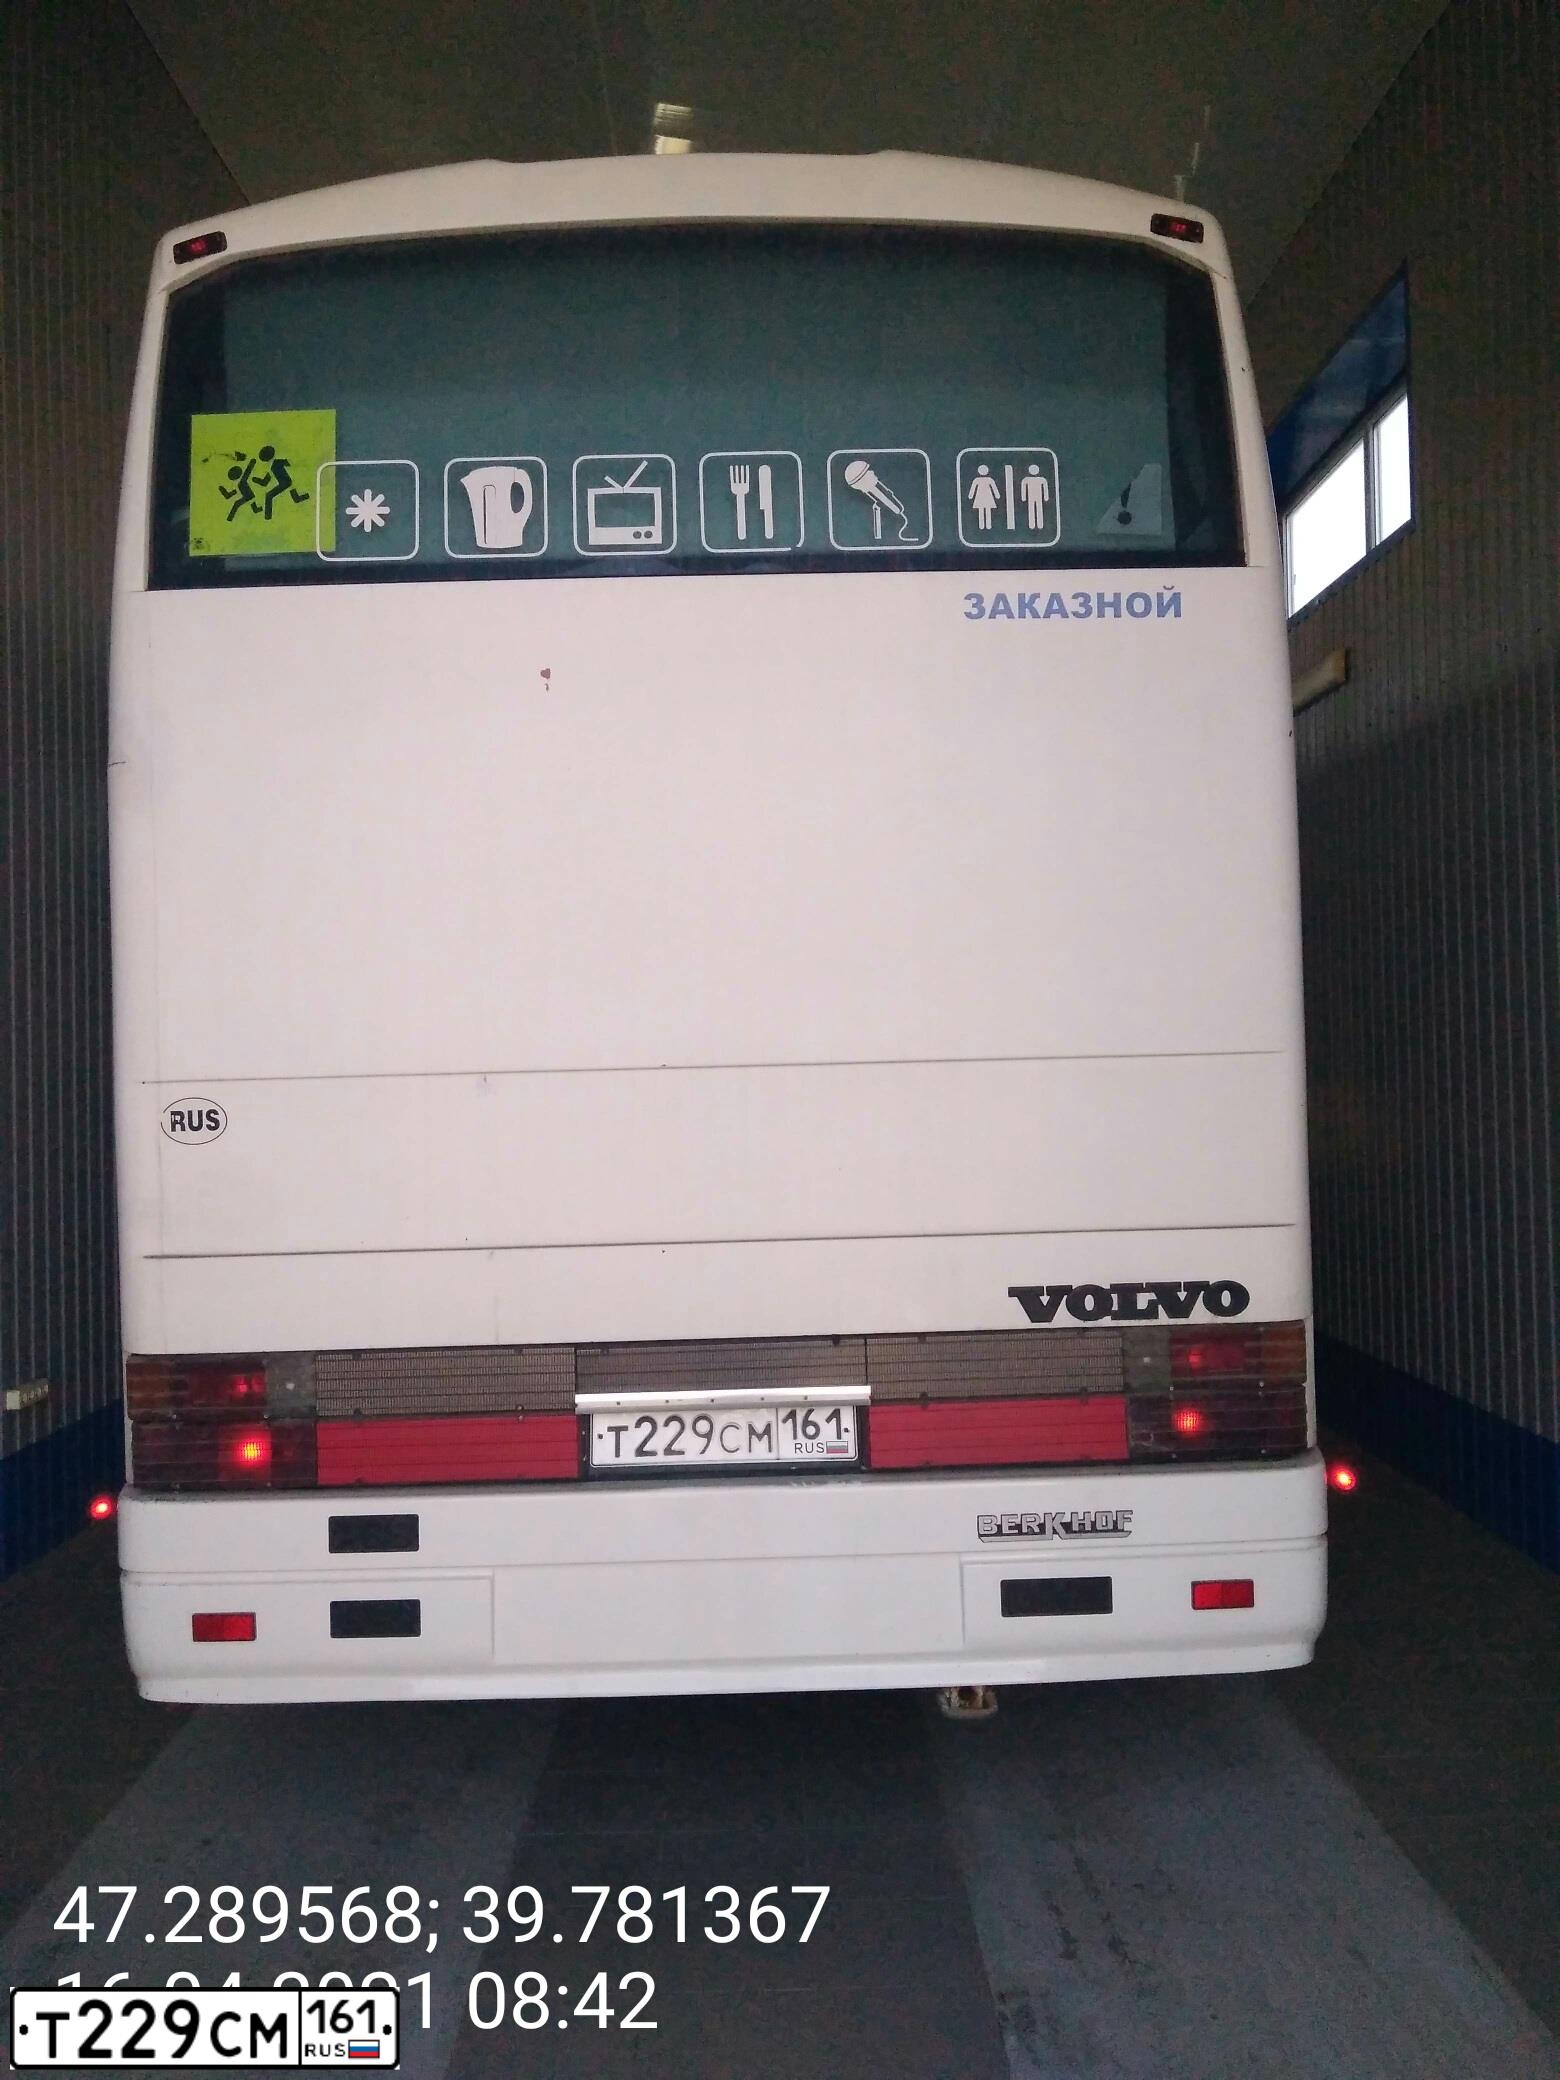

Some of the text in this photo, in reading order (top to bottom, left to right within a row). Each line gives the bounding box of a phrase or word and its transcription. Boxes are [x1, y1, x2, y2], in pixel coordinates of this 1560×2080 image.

[963, 584, 1183, 620] ЗАКАЗНОЙ
[169, 1108, 221, 1133] RUS
[1008, 1279, 1250, 1324] VOLVO
[781, 1408, 843, 1441] 161
[794, 1442, 825, 1454] RUS
[976, 1509, 1134, 1543] BERKHOF
